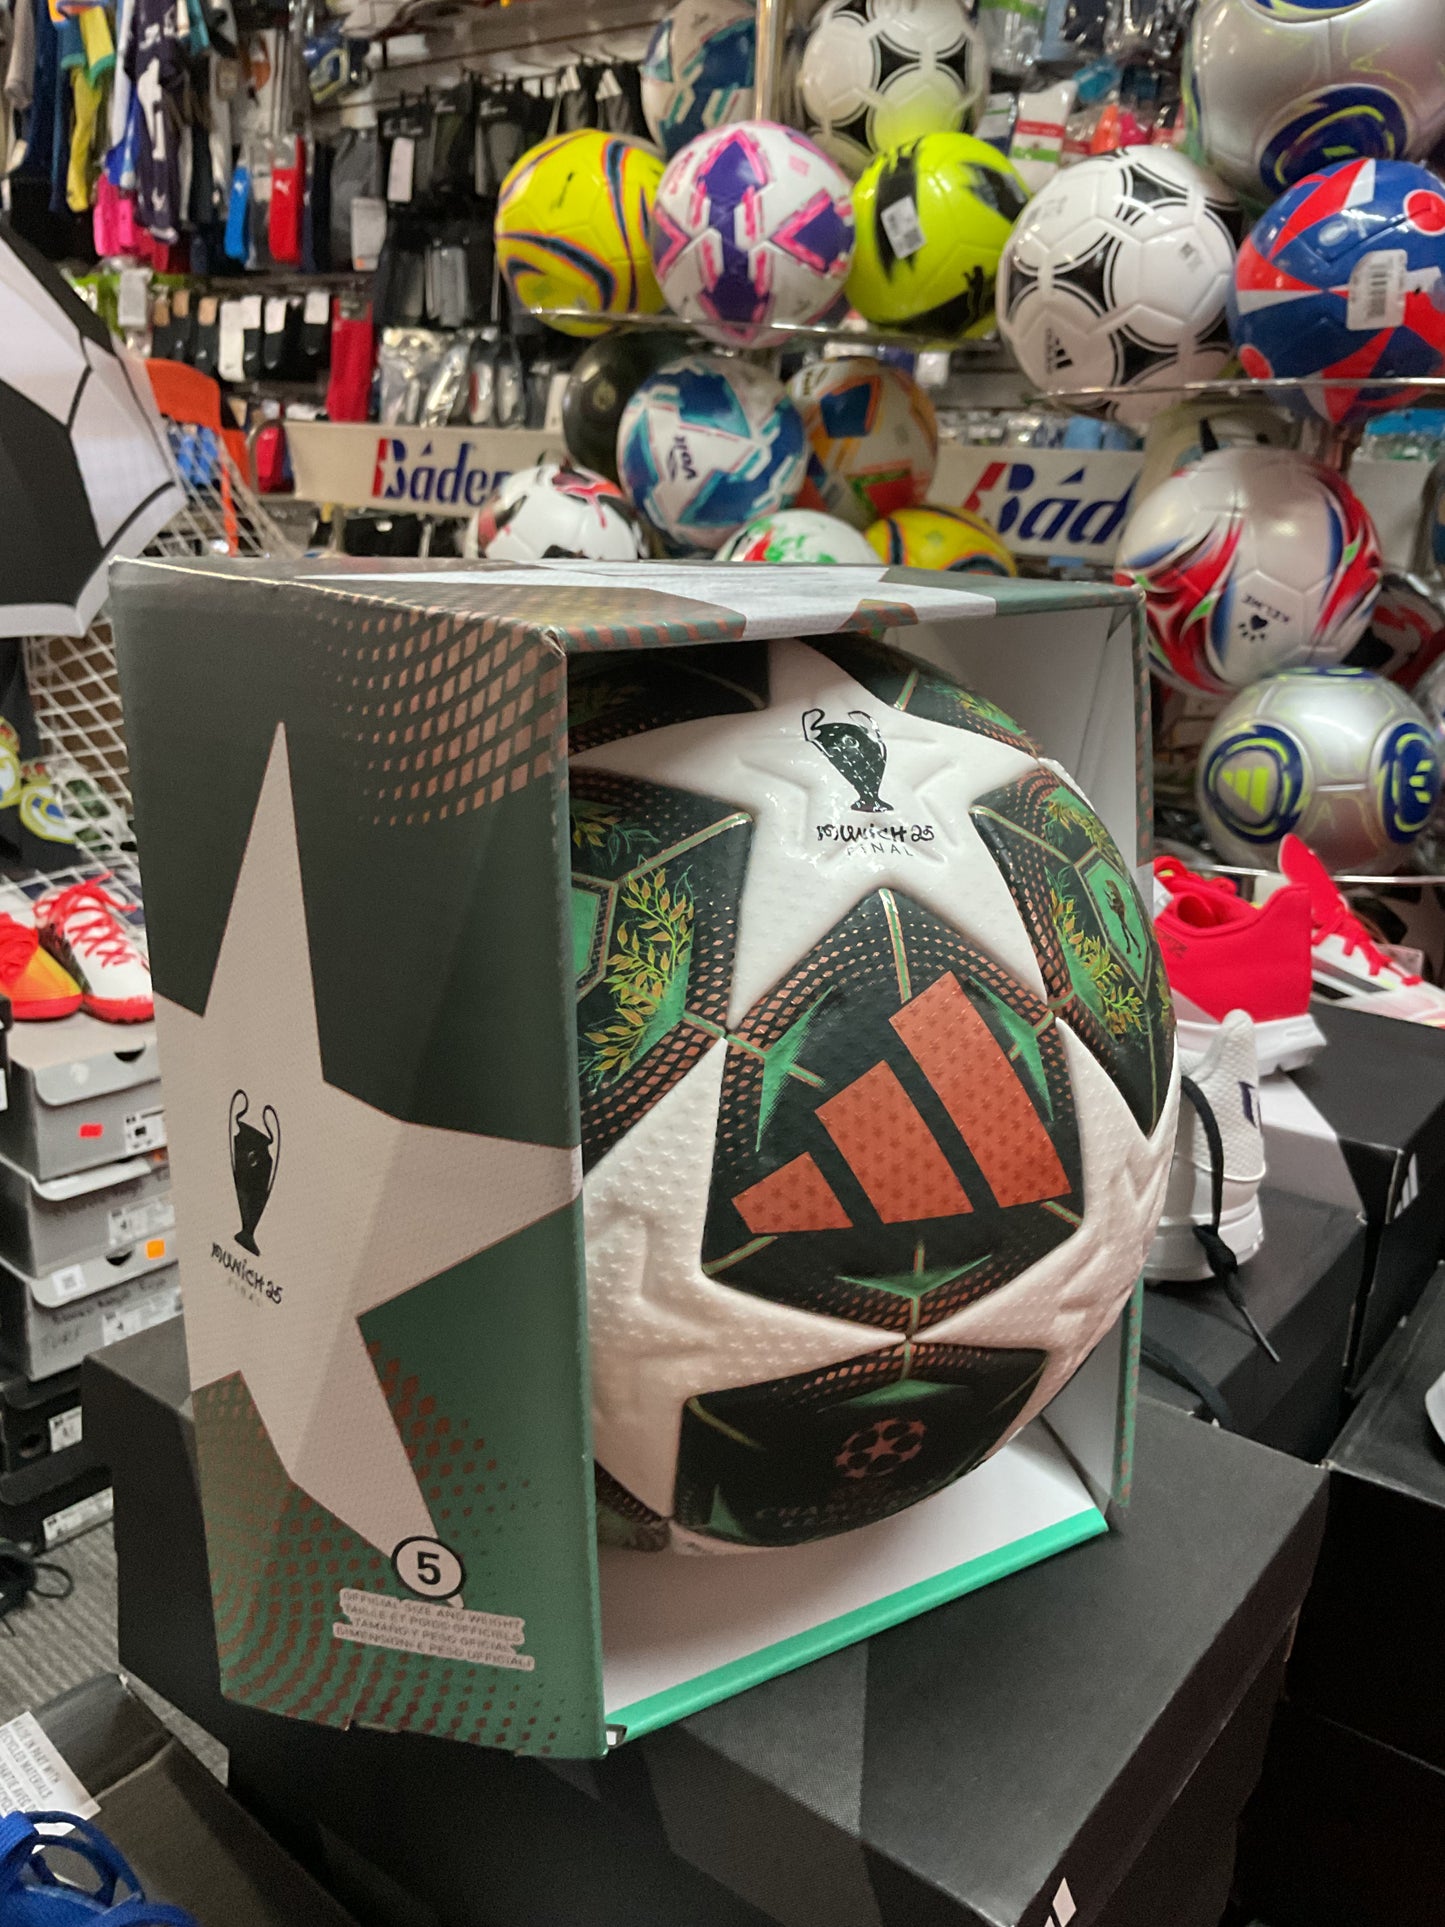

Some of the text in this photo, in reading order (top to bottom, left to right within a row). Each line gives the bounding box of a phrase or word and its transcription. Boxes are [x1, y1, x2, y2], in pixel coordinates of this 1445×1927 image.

[911, 824, 935, 842] 25
[846, 842, 913, 857] FINAL
[265, 1280, 283, 1304] 25
[417, 1551, 442, 1586] 5
[404, 1603, 433, 1616] SIZE
[437, 1608, 465, 1621] AND
[469, 1614, 521, 1630] WEIGHT
[422, 1630, 457, 1644] PESO
[429, 1642, 464, 1657] PESO
